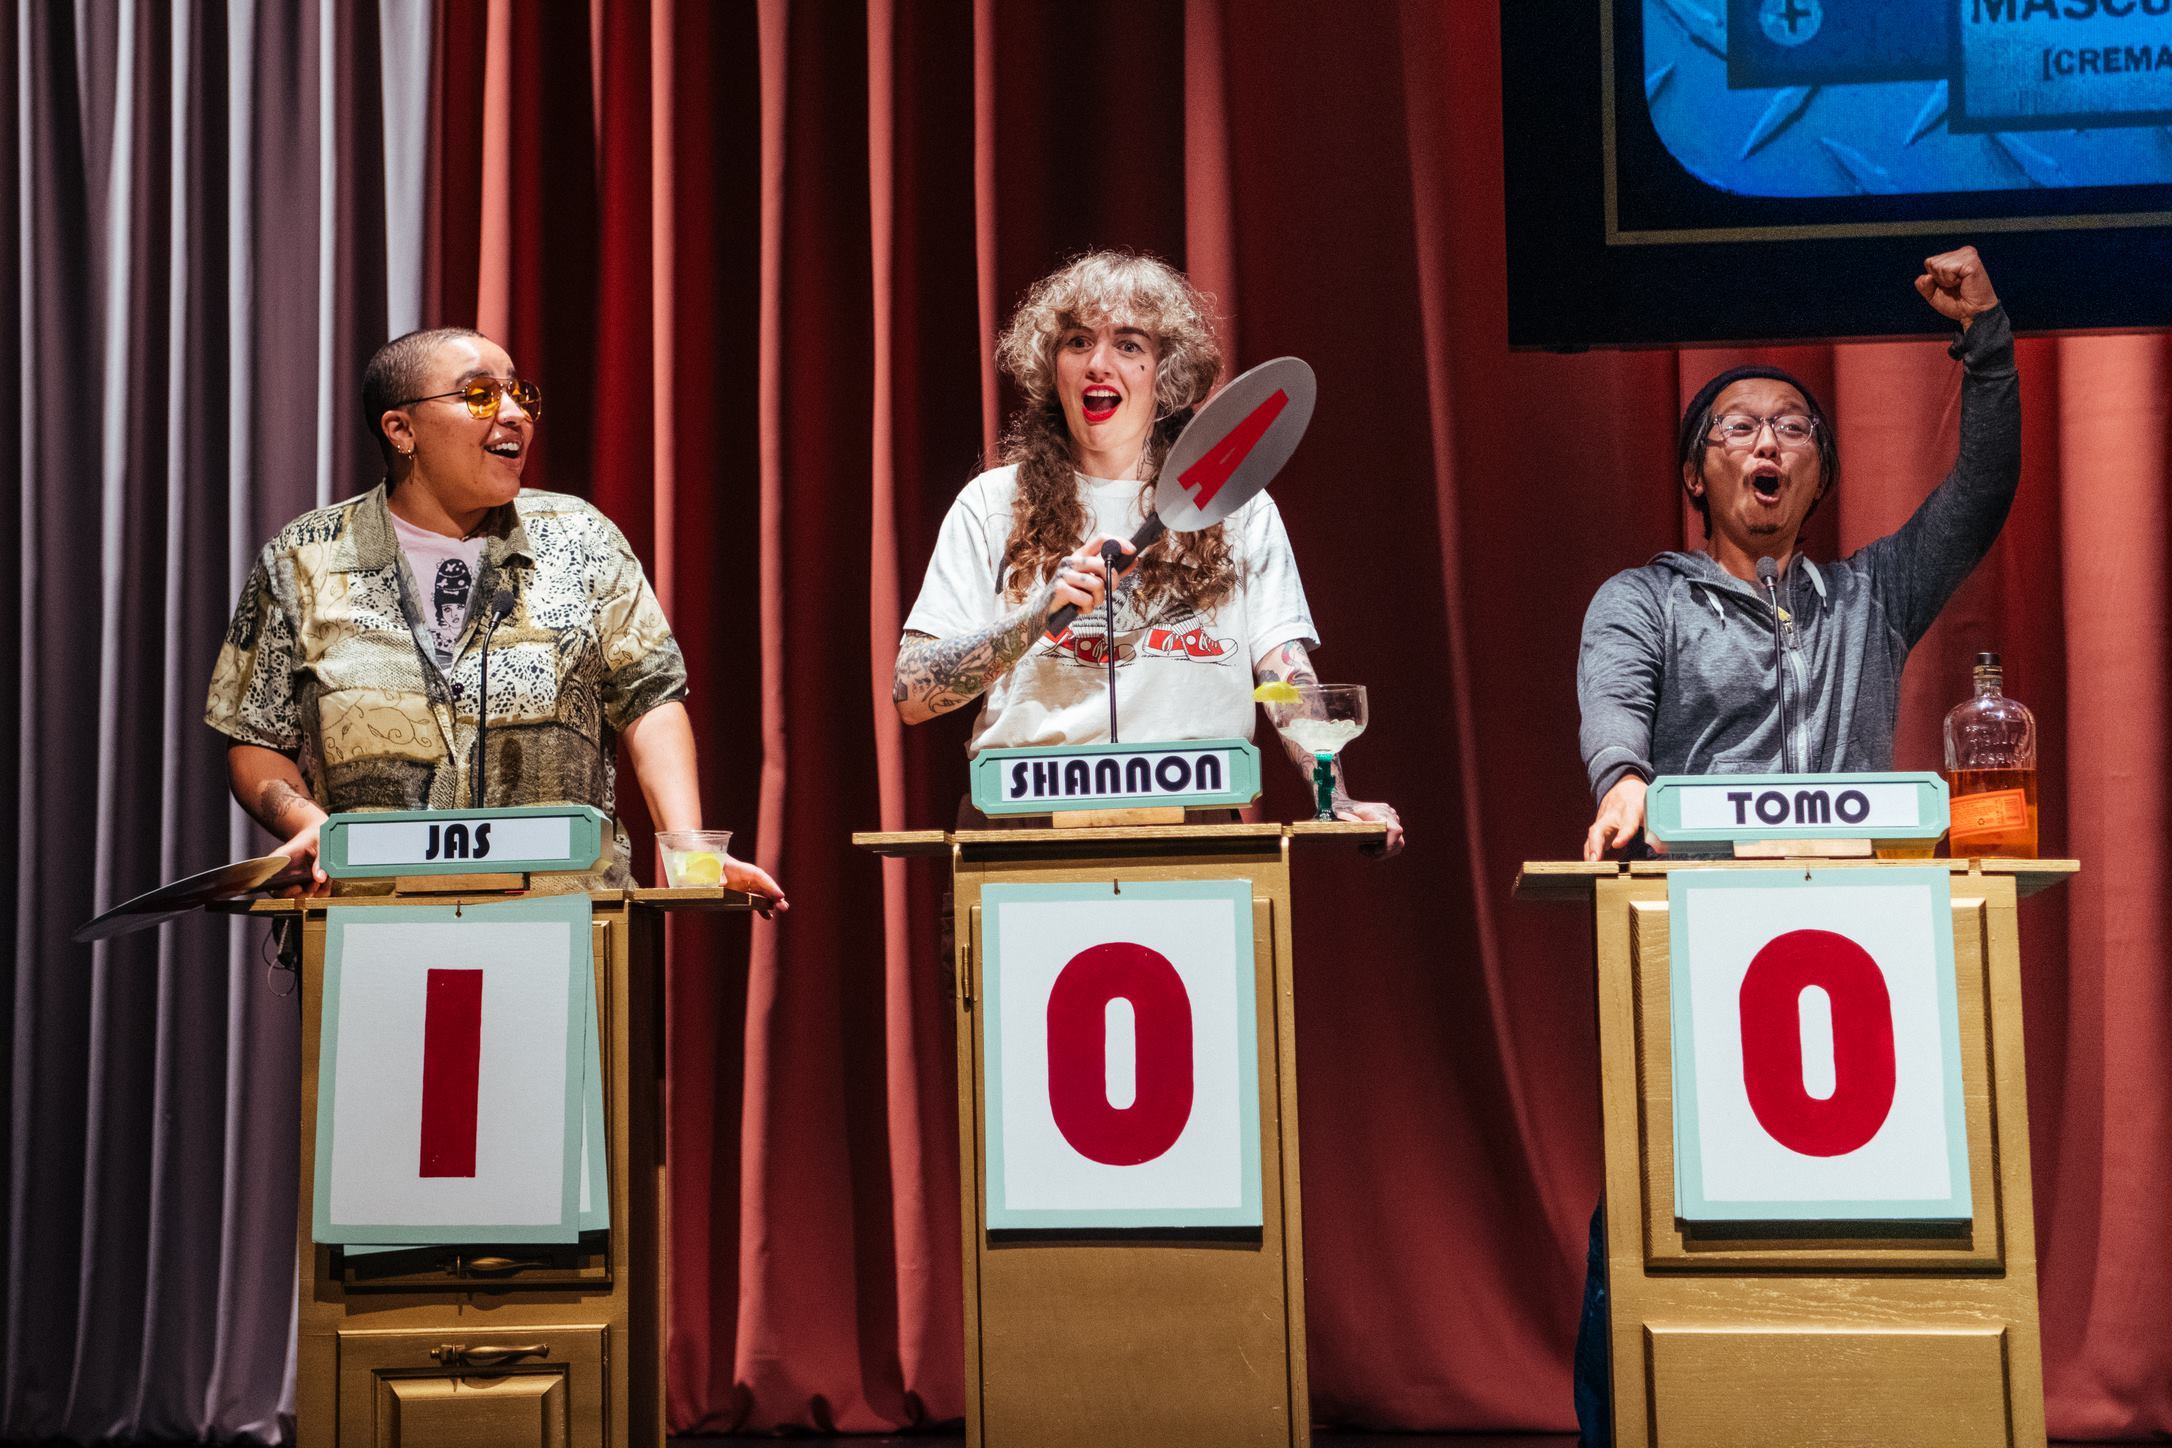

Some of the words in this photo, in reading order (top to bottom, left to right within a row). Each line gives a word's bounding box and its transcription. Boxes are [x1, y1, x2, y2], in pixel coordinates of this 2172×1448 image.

[1177, 388, 1290, 512] A
[1010, 753, 1222, 799] SHANNON
[1726, 788, 1872, 826] TOMO
[425, 822, 492, 861] JAS
